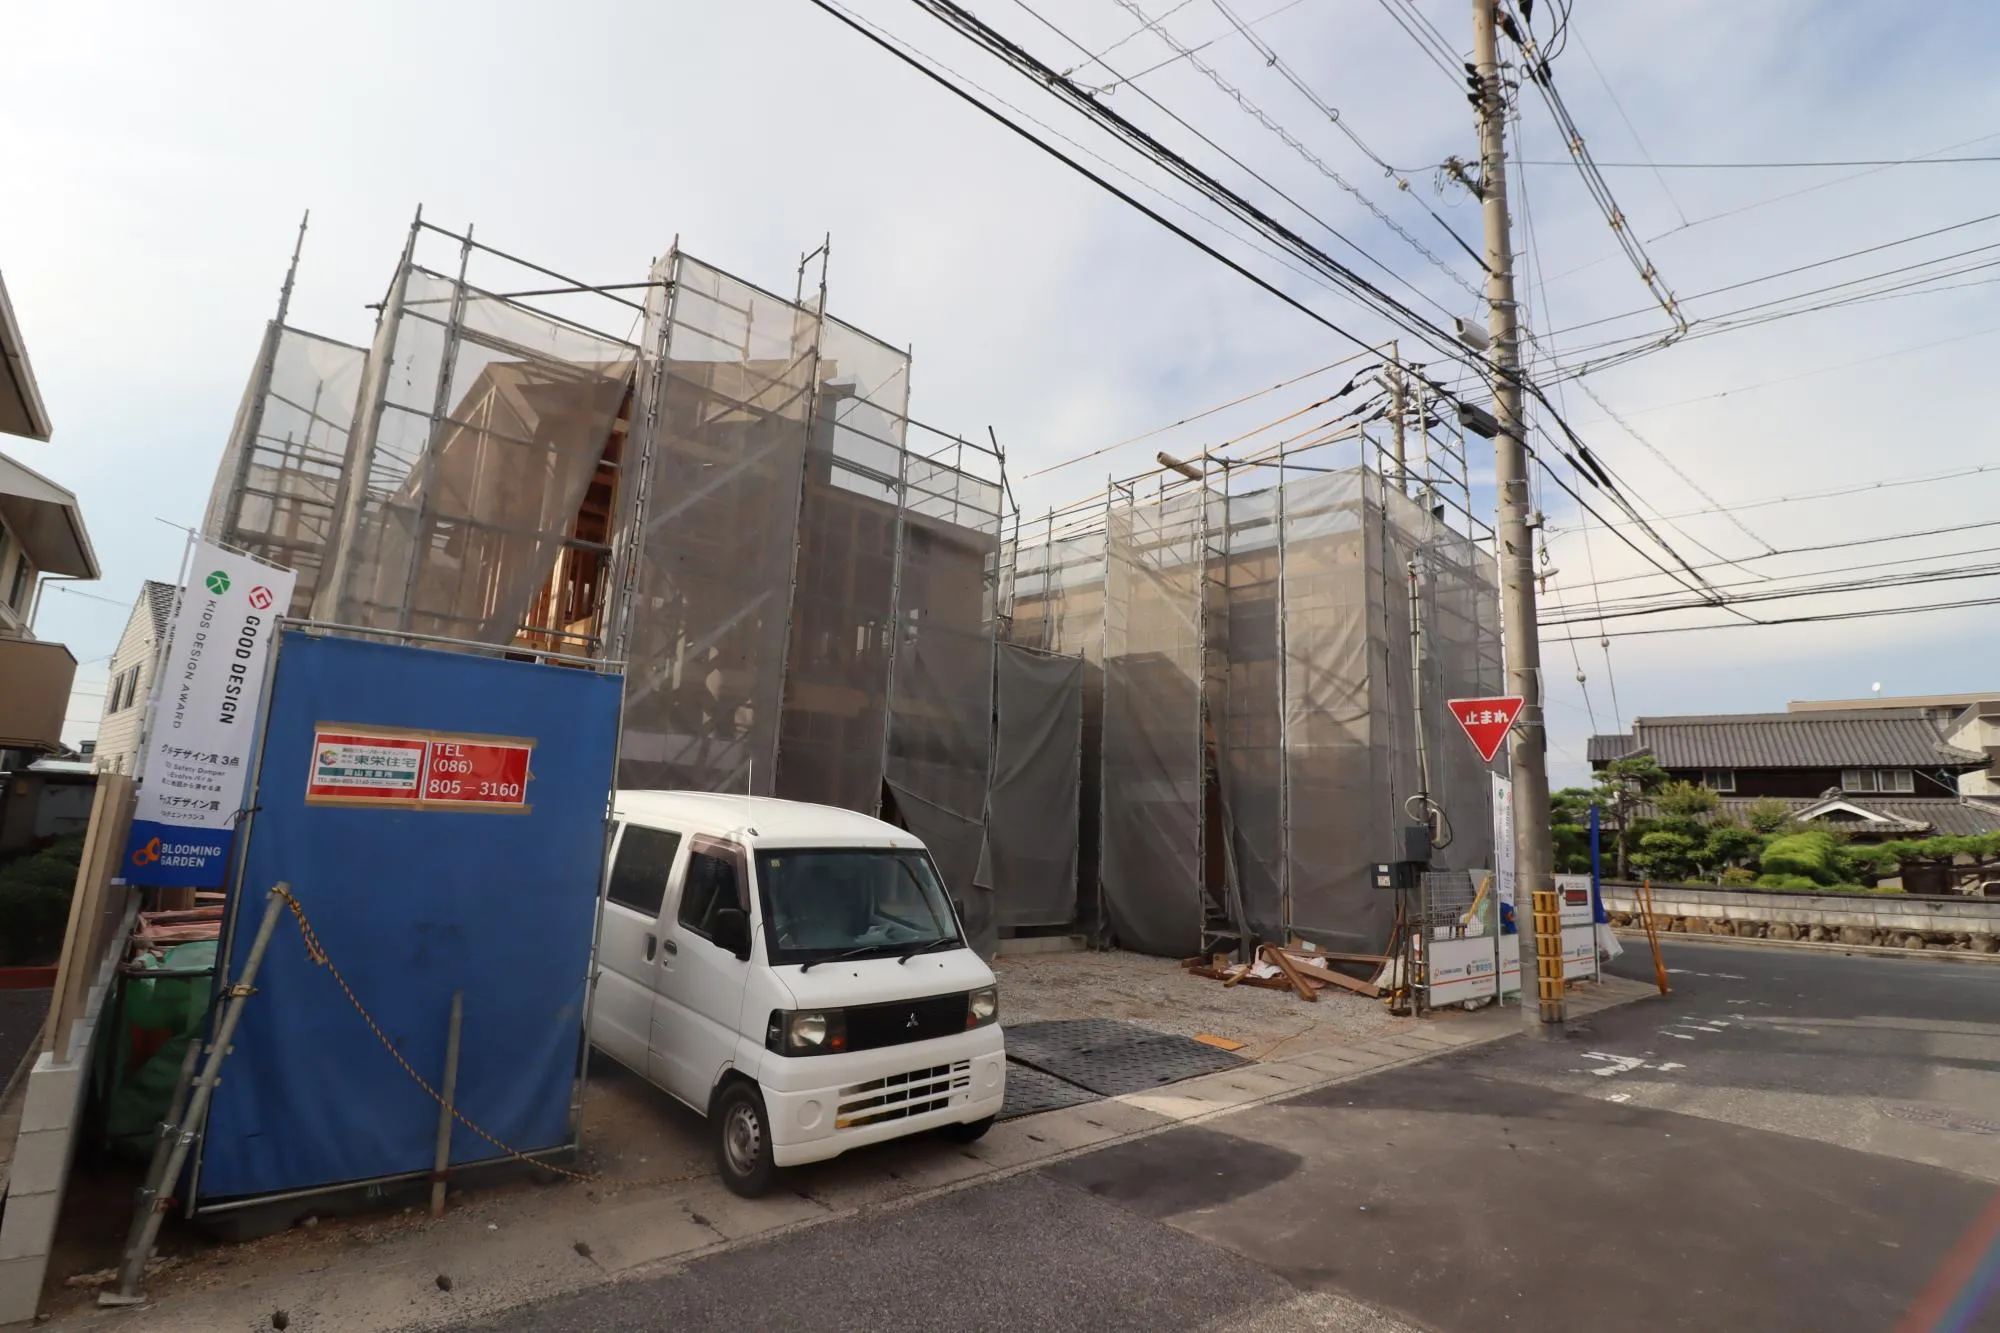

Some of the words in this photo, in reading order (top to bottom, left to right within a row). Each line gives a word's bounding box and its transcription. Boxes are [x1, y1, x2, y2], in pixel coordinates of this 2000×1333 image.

[200, 600, 217, 629] KIDS
[235, 615, 261, 659] GOOD
[184, 632, 207, 680] DESIGN
[219, 663, 247, 724] DESIGN
[173, 683, 190, 729] AWARD
[1464, 709, 1509, 725] 止まれ
[434, 743, 464, 757] TEL
[433, 758, 473, 775] (086)
[160, 855, 205, 867] GARDEN
[161, 843, 221, 856] BLOOMING
